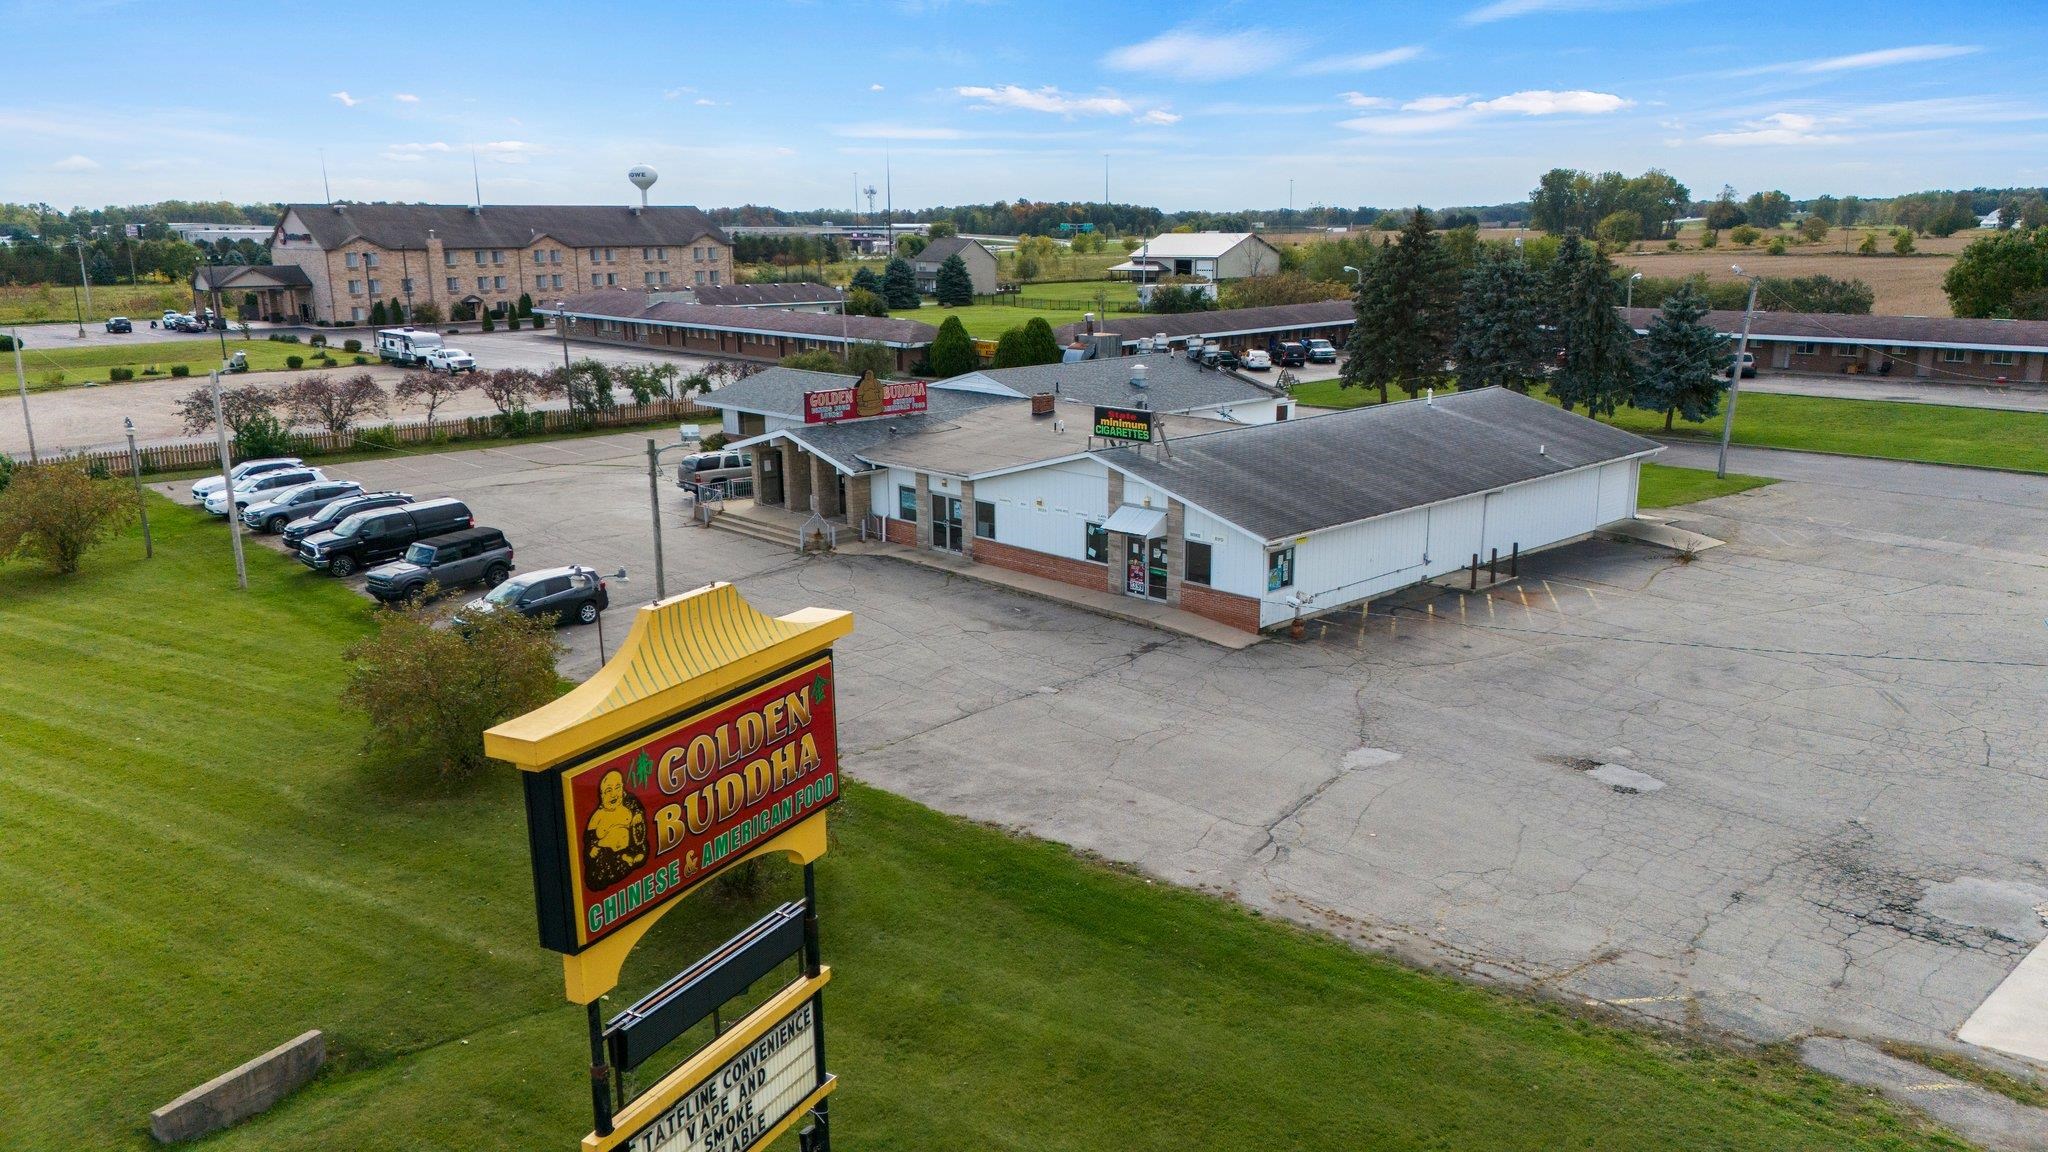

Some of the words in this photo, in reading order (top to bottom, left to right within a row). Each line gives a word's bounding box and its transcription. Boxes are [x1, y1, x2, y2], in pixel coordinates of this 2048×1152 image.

[810, 390, 853, 406] GOLDEN
[883, 383, 925, 399] BUDDHA
[1107, 410, 1138, 420] State
[1095, 424, 1150, 440] CIGARETTES
[1100, 417, 1148, 430] minimum
[657, 685, 813, 795] GOLDEN
[654, 732, 821, 855] BUDDHA
[588, 860, 680, 933] CHINESE
[683, 850, 698, 879] &
[701, 796, 793, 869] AMERICAN
[795, 773, 835, 814] FOOD
[723, 1007, 811, 1089] CONVENIENCE
[739, 1068, 766, 1103] AND
[705, 1100, 754, 1152] SMOKE
